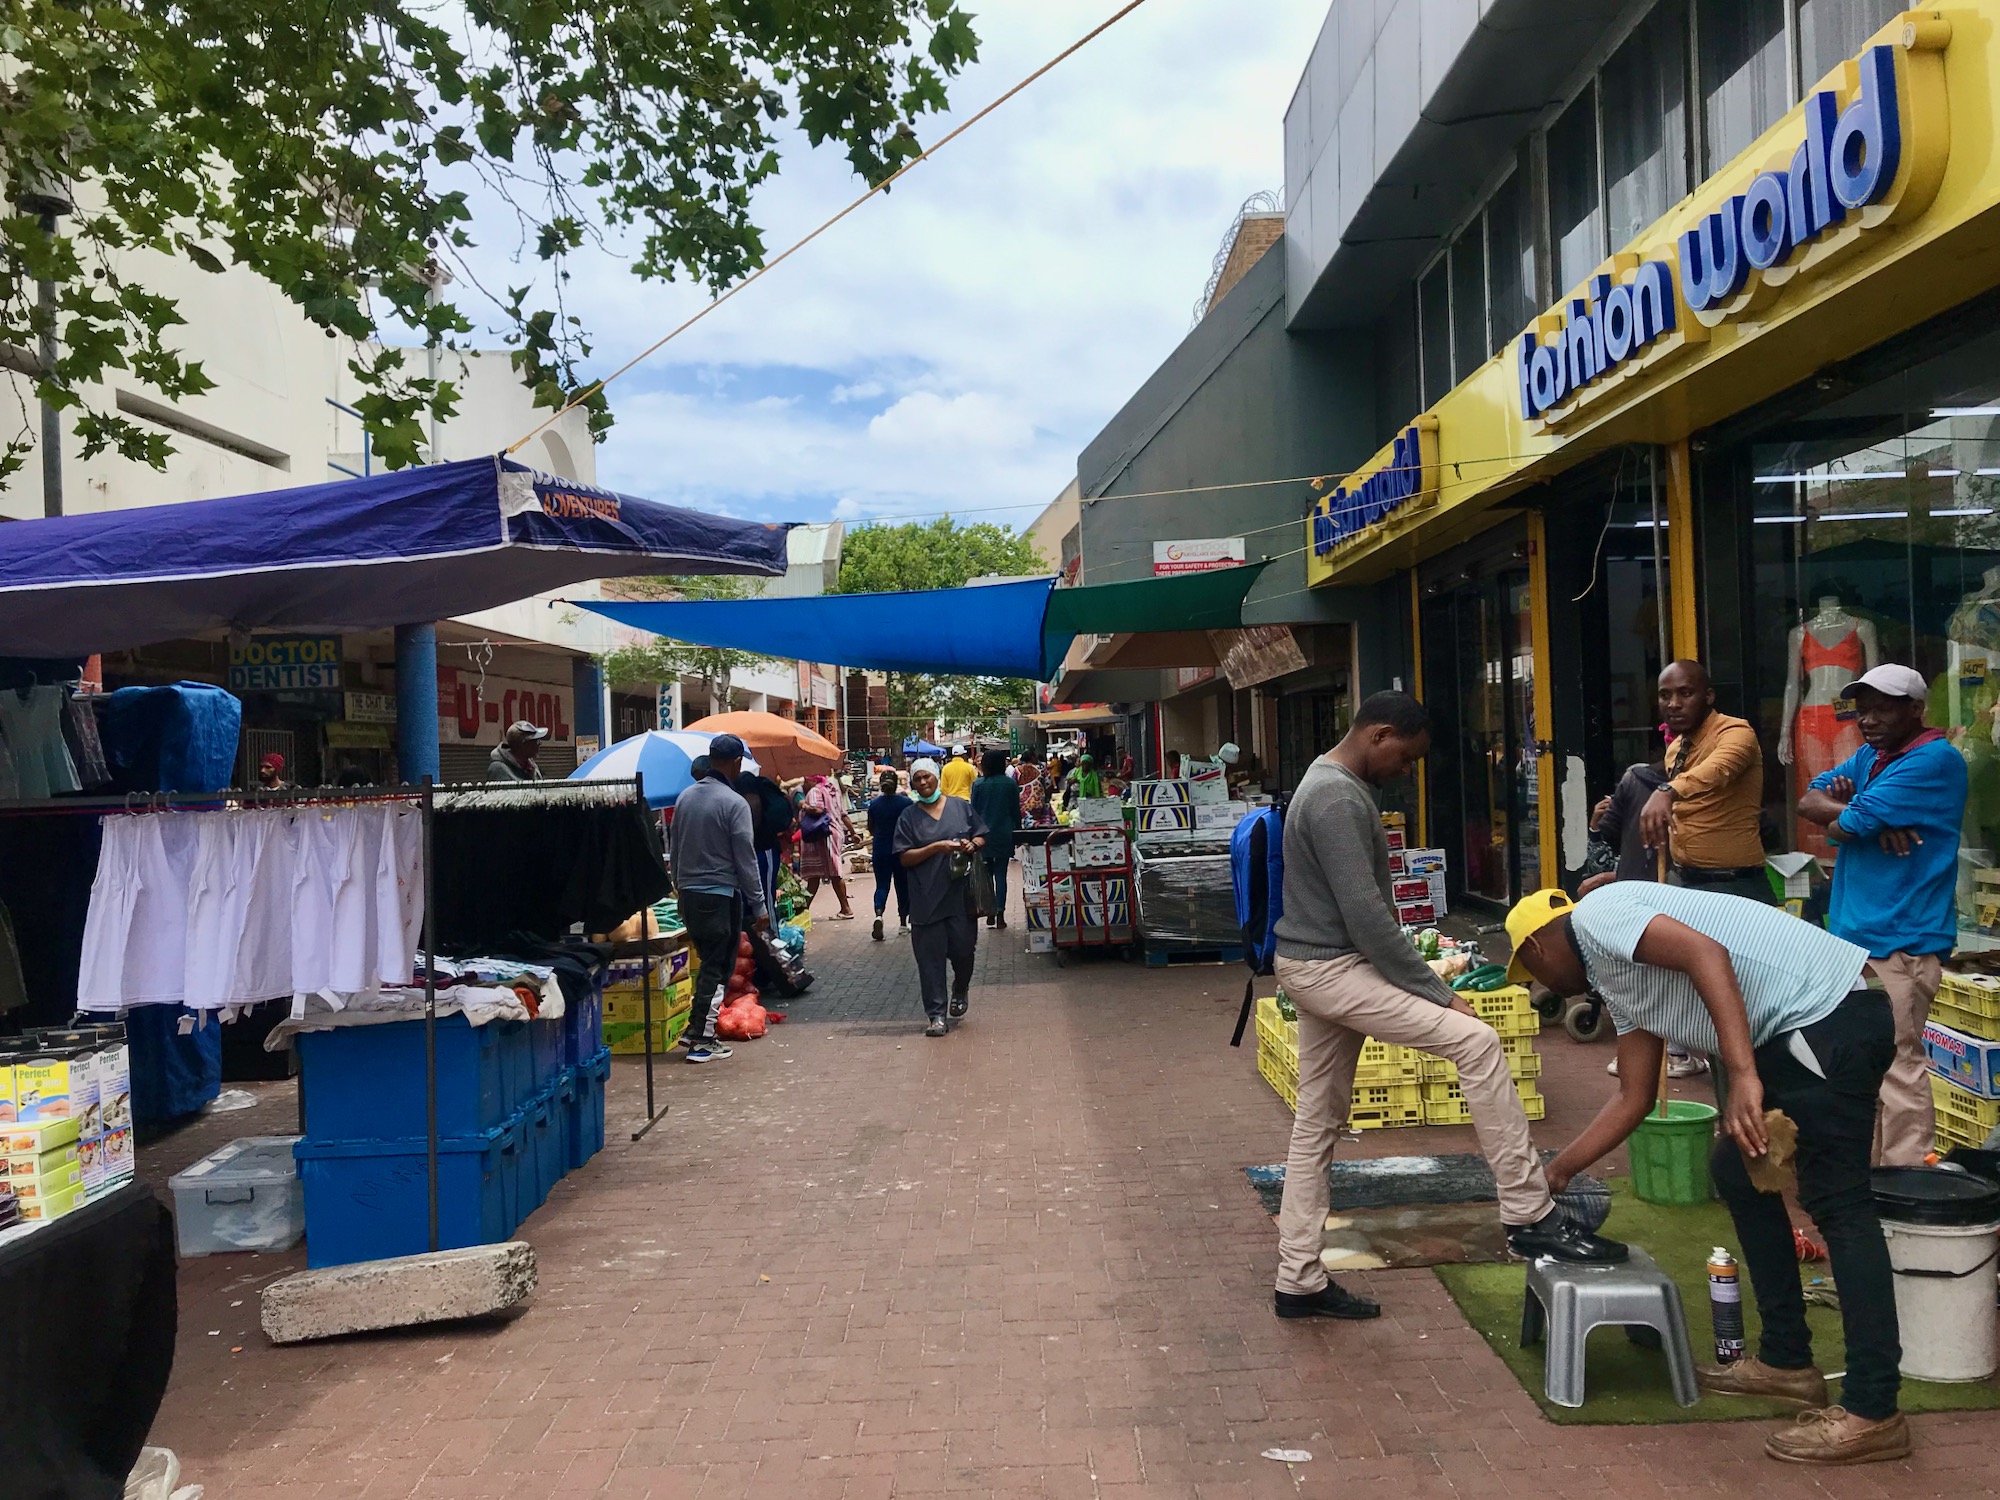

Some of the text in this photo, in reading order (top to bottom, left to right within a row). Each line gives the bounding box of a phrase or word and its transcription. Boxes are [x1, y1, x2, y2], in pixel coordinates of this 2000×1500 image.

[1518, 44, 1900, 421] fashion world
[543, 493, 620, 522] ADVENTURES
[1184, 562, 1204, 570] SAFETY
[1208, 561, 1240, 569] PROTECTION
[229, 640, 337, 666] DOCTOR
[230, 664, 337, 689] DENTIST
[458, 684, 569, 741] U-COOL
[619, 706, 637, 734] HIFI
[659, 684, 673, 731] PHON
[70, 1061, 90, 1075] Perfect
[99, 1052, 120, 1065] Perfect
[19, 1069, 50, 1080] Perfect
